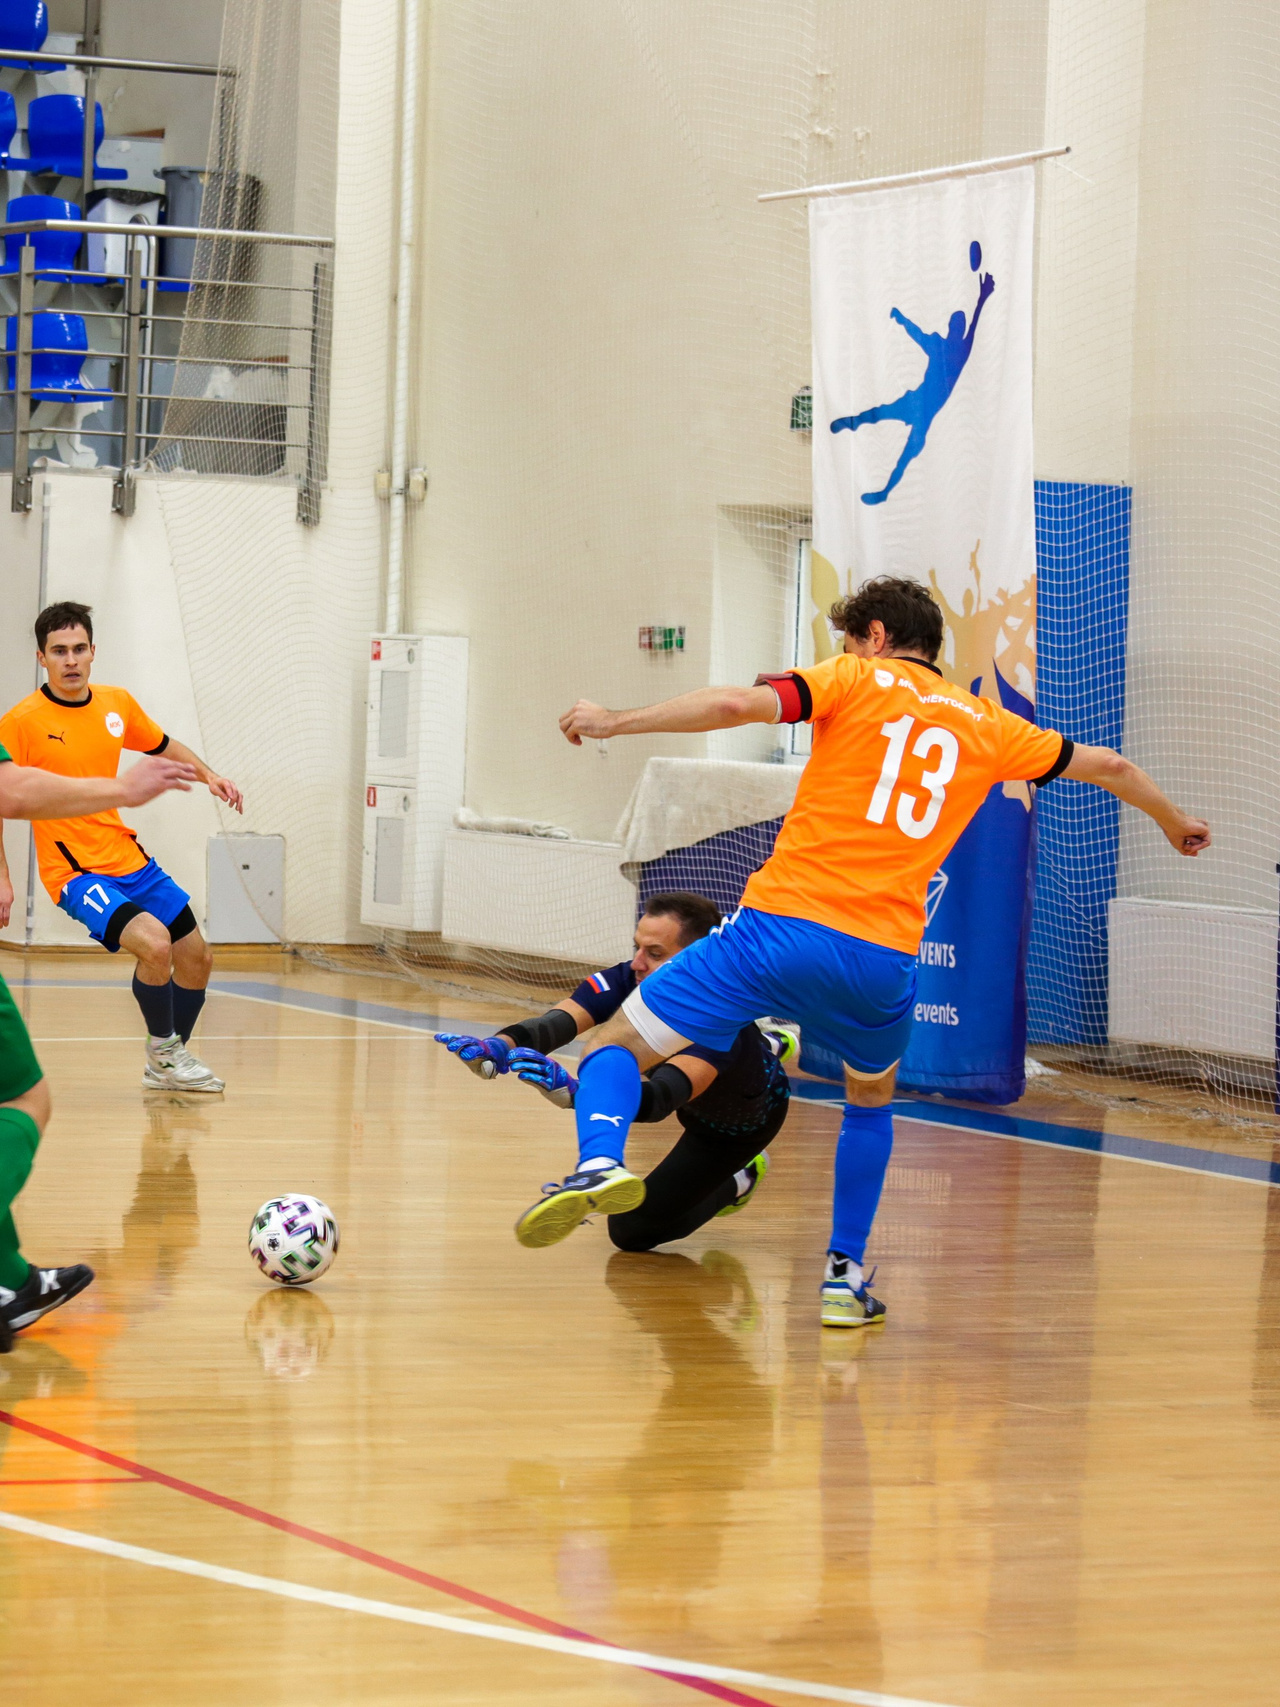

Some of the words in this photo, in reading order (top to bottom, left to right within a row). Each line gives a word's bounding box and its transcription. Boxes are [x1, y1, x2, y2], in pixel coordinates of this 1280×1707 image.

[865, 714, 959, 840] 13
[82, 883, 111, 914] 17
[916, 941, 956, 969] VENTS
[913, 1002, 960, 1026] events
